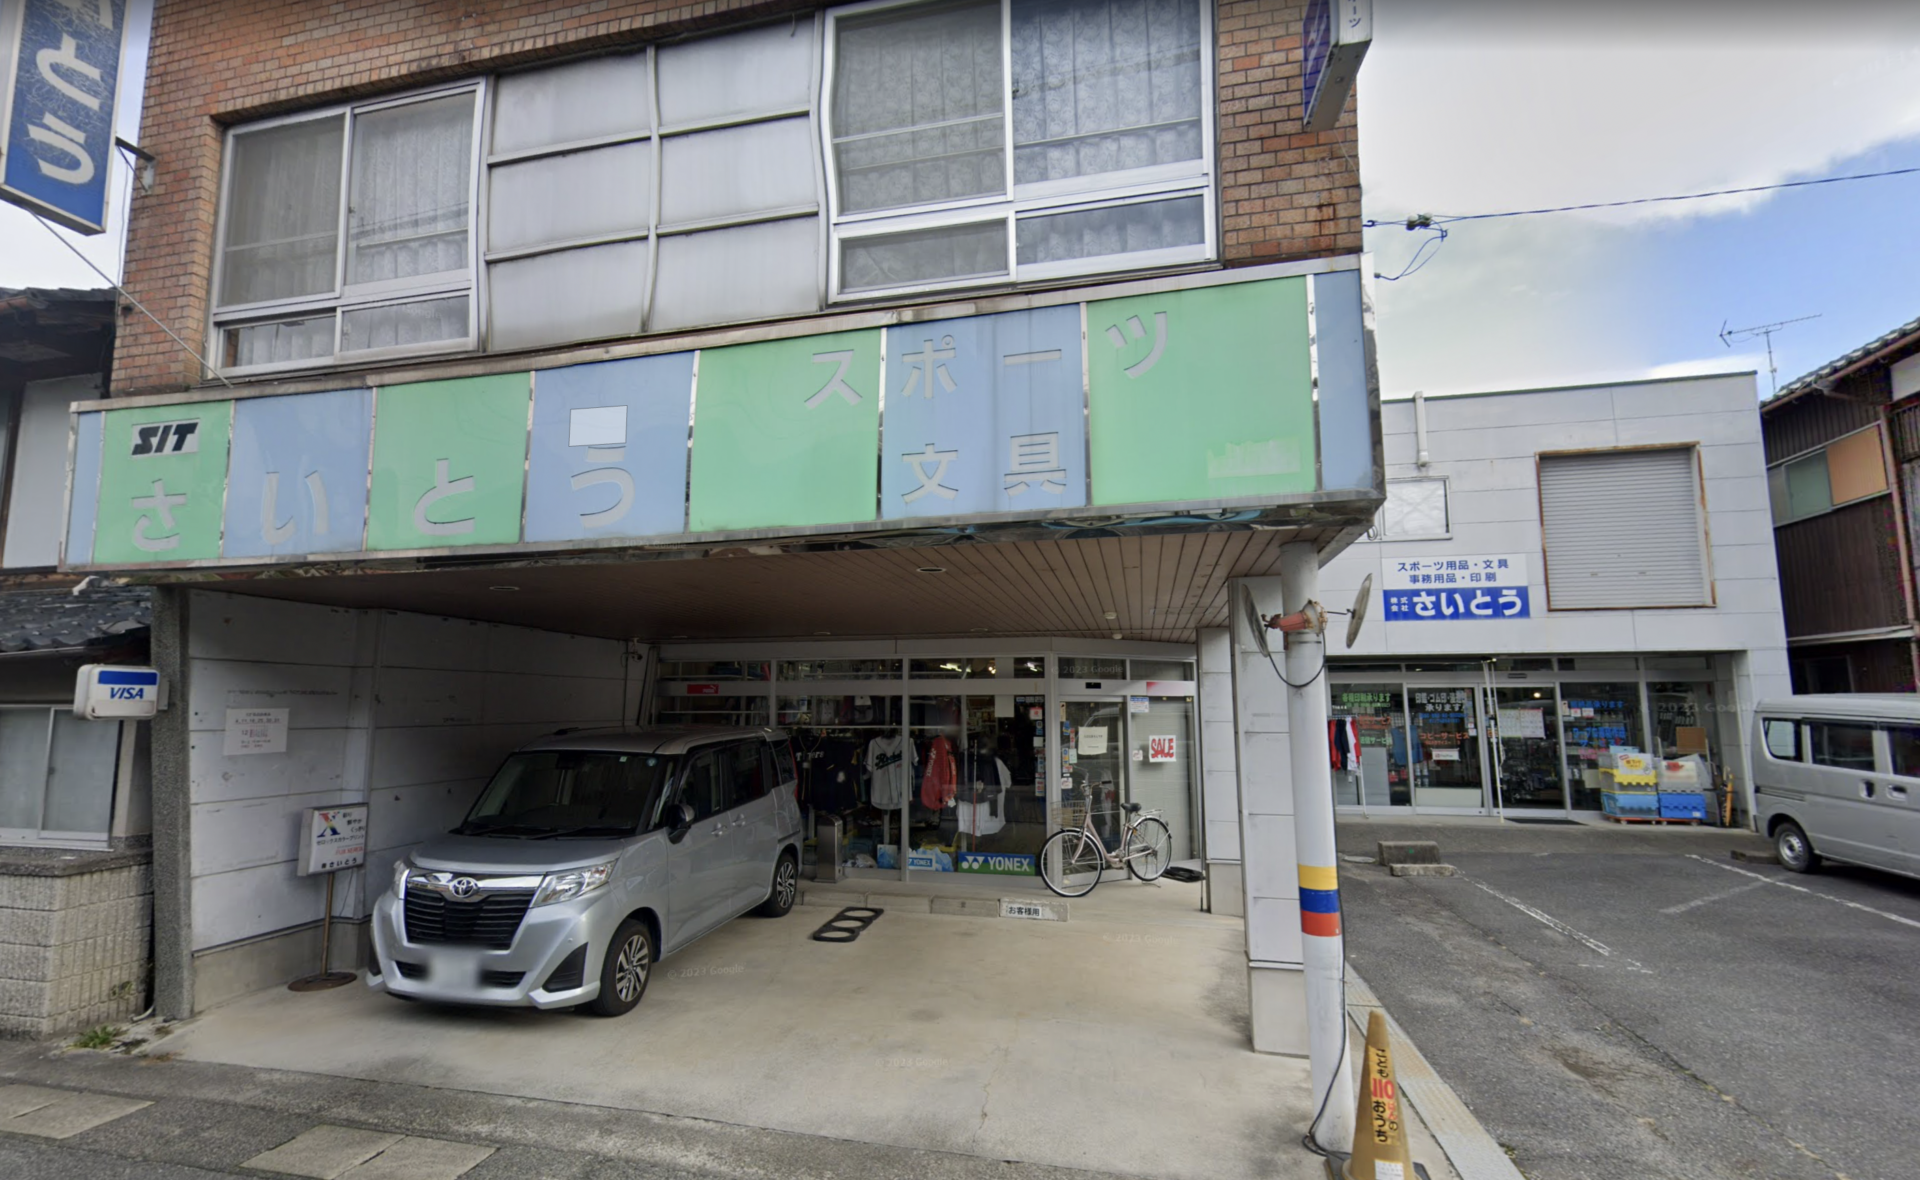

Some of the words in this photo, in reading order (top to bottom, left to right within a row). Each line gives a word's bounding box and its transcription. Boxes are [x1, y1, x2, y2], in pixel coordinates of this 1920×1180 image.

[27, 0, 113, 185] とう
[804, 311, 1168, 410] スポーツ
[131, 422, 199, 456] SIT
[901, 431, 1067, 504] 文具
[131, 445, 636, 552] さいとう
[1412, 589, 1522, 617] さいとう
[110, 687, 144, 700] VISA
[1150, 738, 1175, 759] SALE
[988, 856, 1030, 872] YONEX
[1008, 906, 1040, 917] お客様用
[1371, 1078, 1395, 1100] 110
